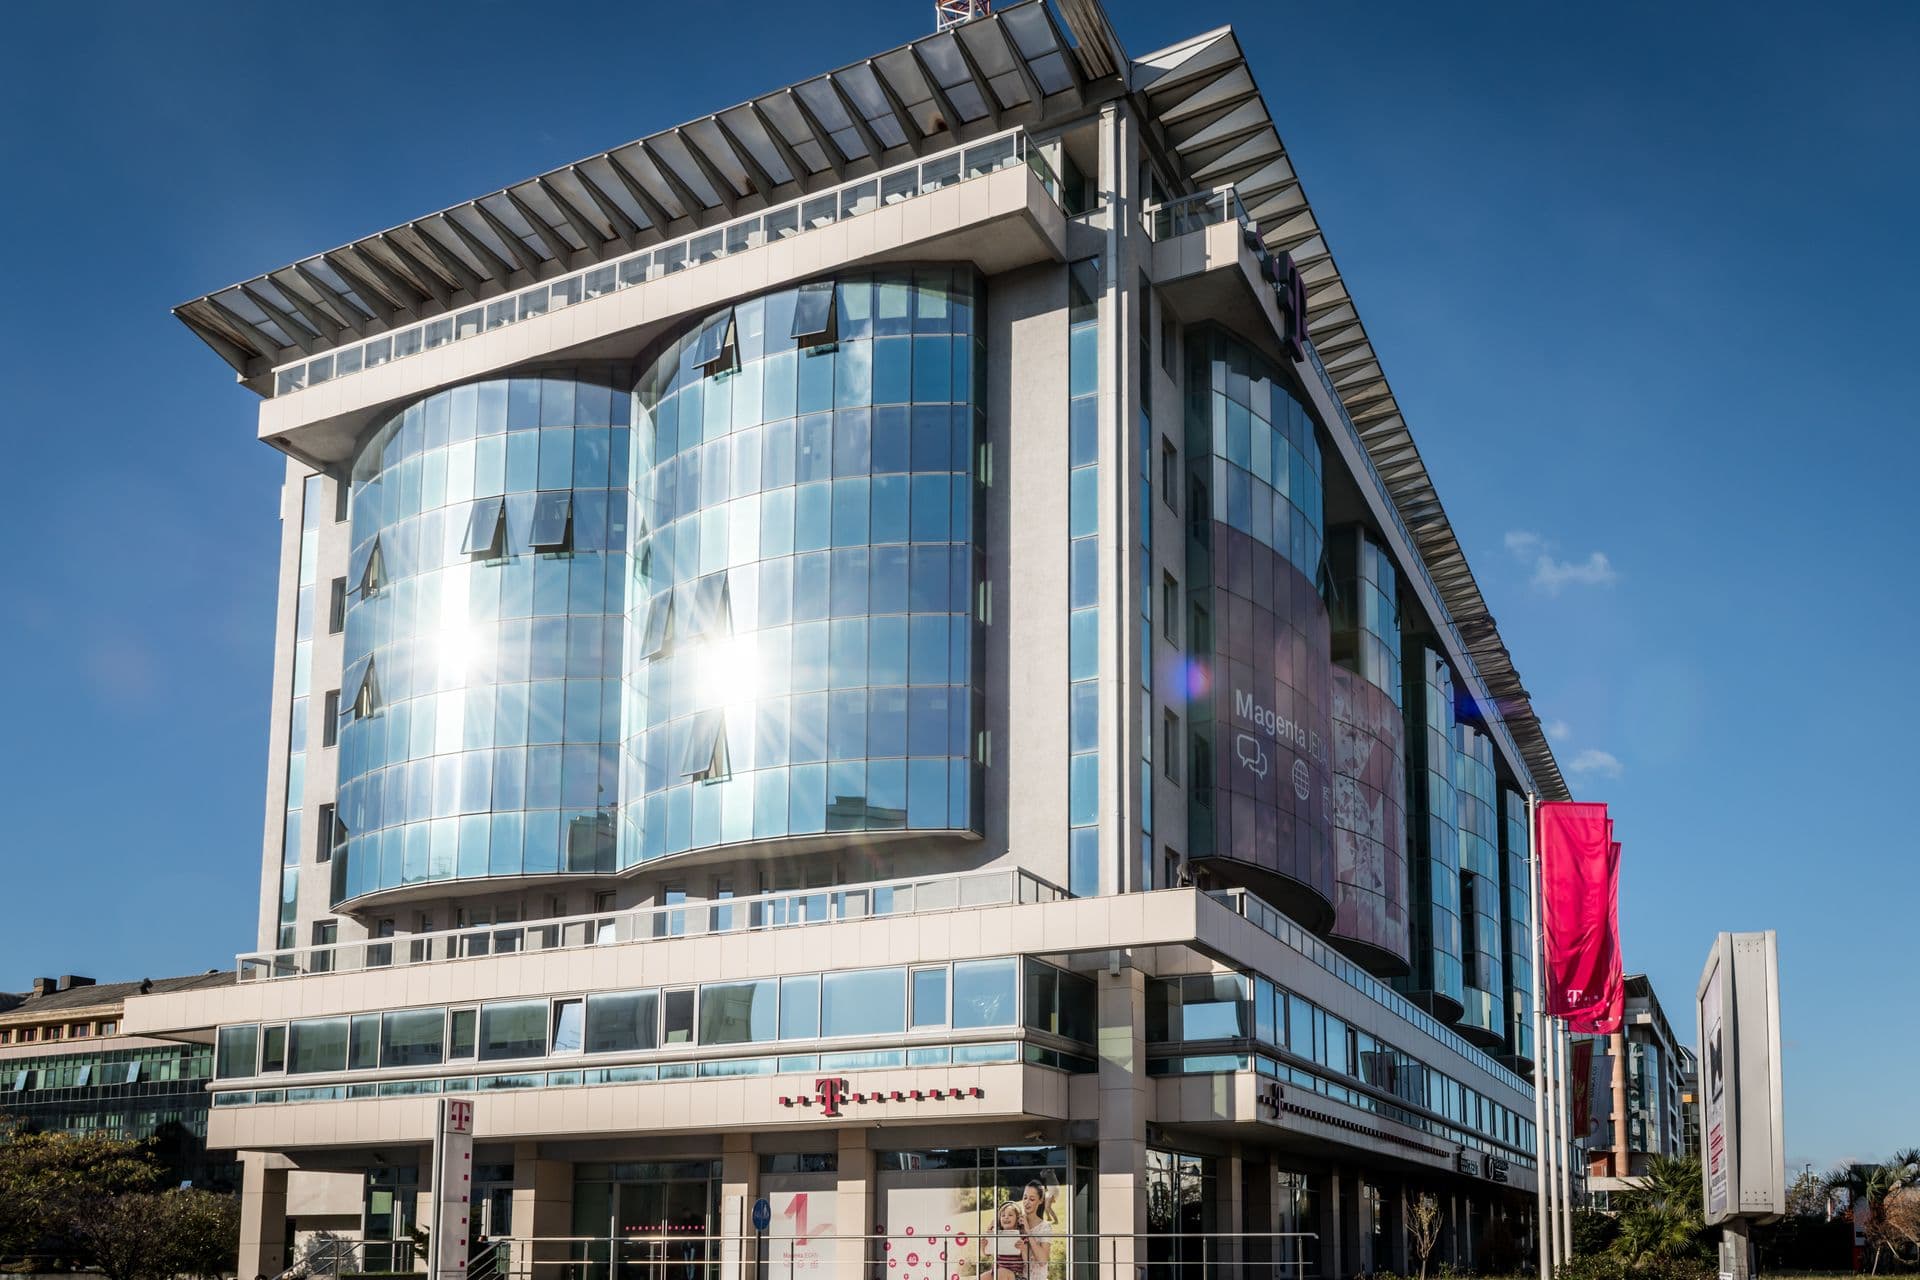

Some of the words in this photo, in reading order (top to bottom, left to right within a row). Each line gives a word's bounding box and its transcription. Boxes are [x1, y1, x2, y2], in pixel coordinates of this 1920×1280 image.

[1235, 688, 1306, 750] Magenta
[1567, 989, 1583, 1008] T
[815, 1077, 843, 1116] T
[451, 1101, 471, 1131] T
